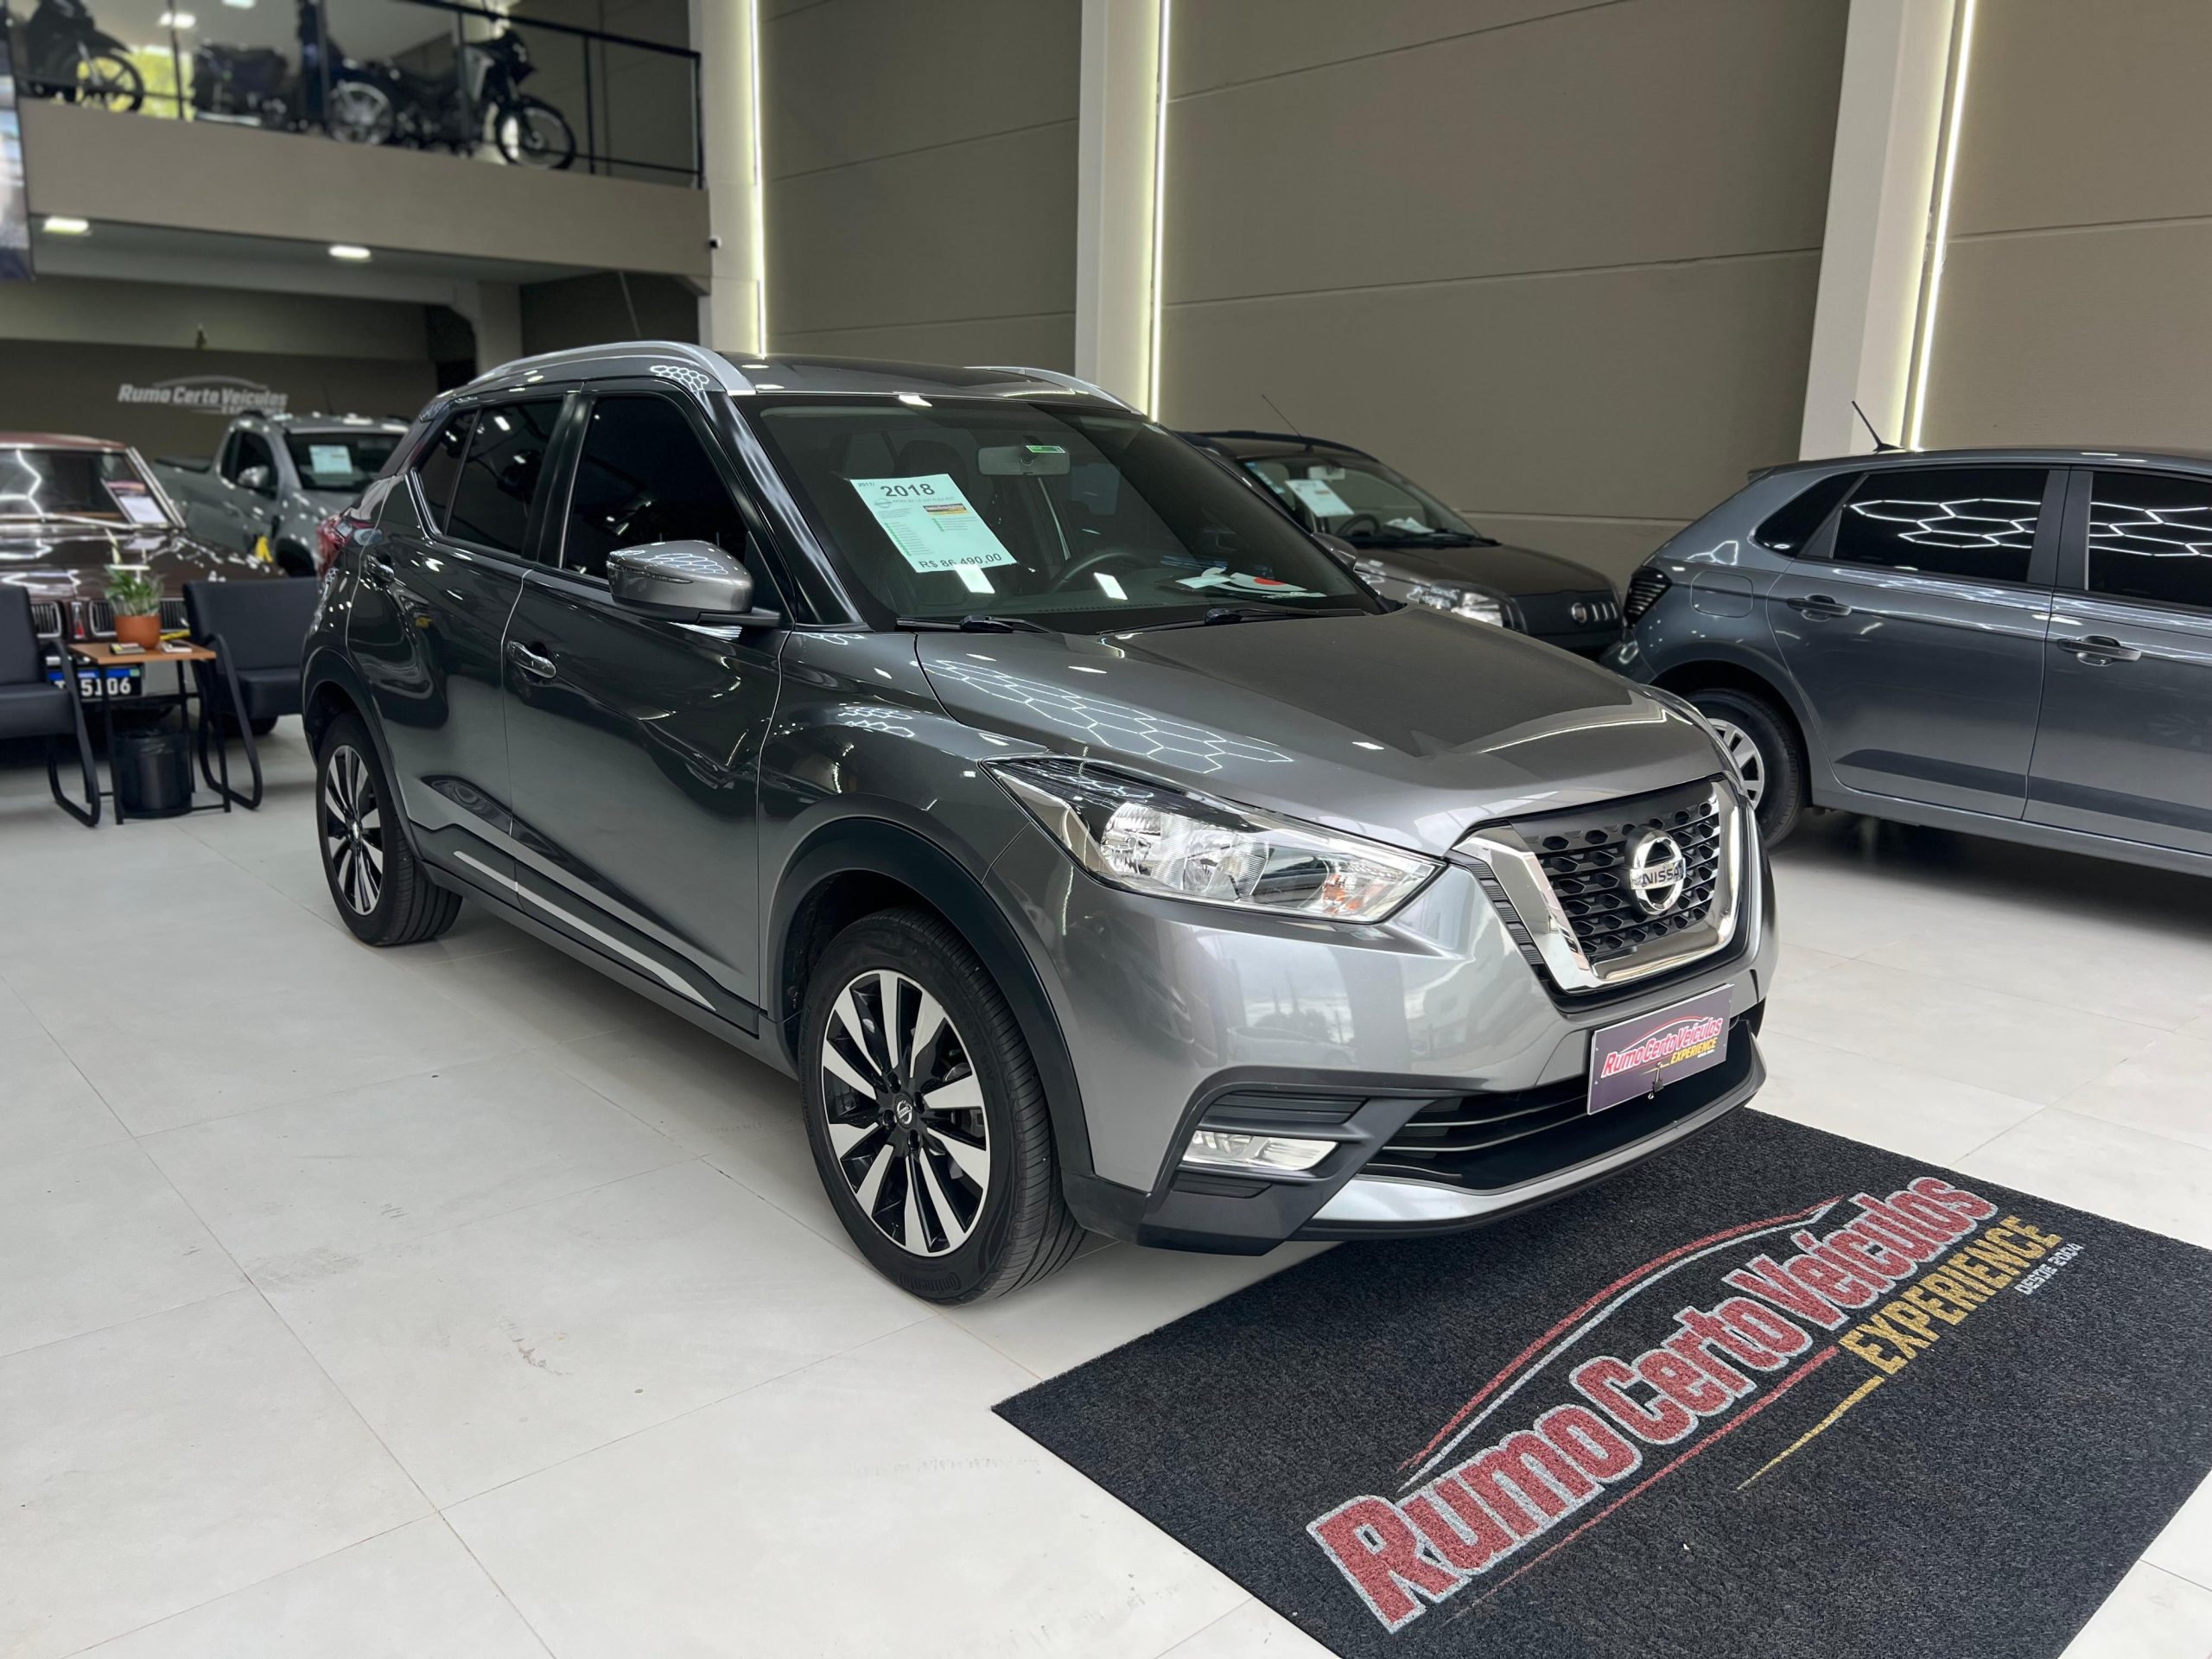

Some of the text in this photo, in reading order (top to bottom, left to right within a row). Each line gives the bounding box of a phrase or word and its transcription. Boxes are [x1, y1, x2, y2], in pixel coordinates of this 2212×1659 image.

[118, 384, 171, 403] Rumo
[172, 386, 221, 404] Certo
[880, 483, 936, 497] 2018
[918, 553, 1002, 569] R$ 86490,00
[1600, 1046, 1645, 1078] Rumo
[1642, 1033, 1678, 1063] Certo
[1670, 1037, 1718, 1065] EXPERIENCE
[2014, 1263, 2057, 1295] DESDE
[1838, 1214, 2063, 1376] EXPERIENCE
[1306, 1176, 1999, 1634] Rumo Certo Veículos
